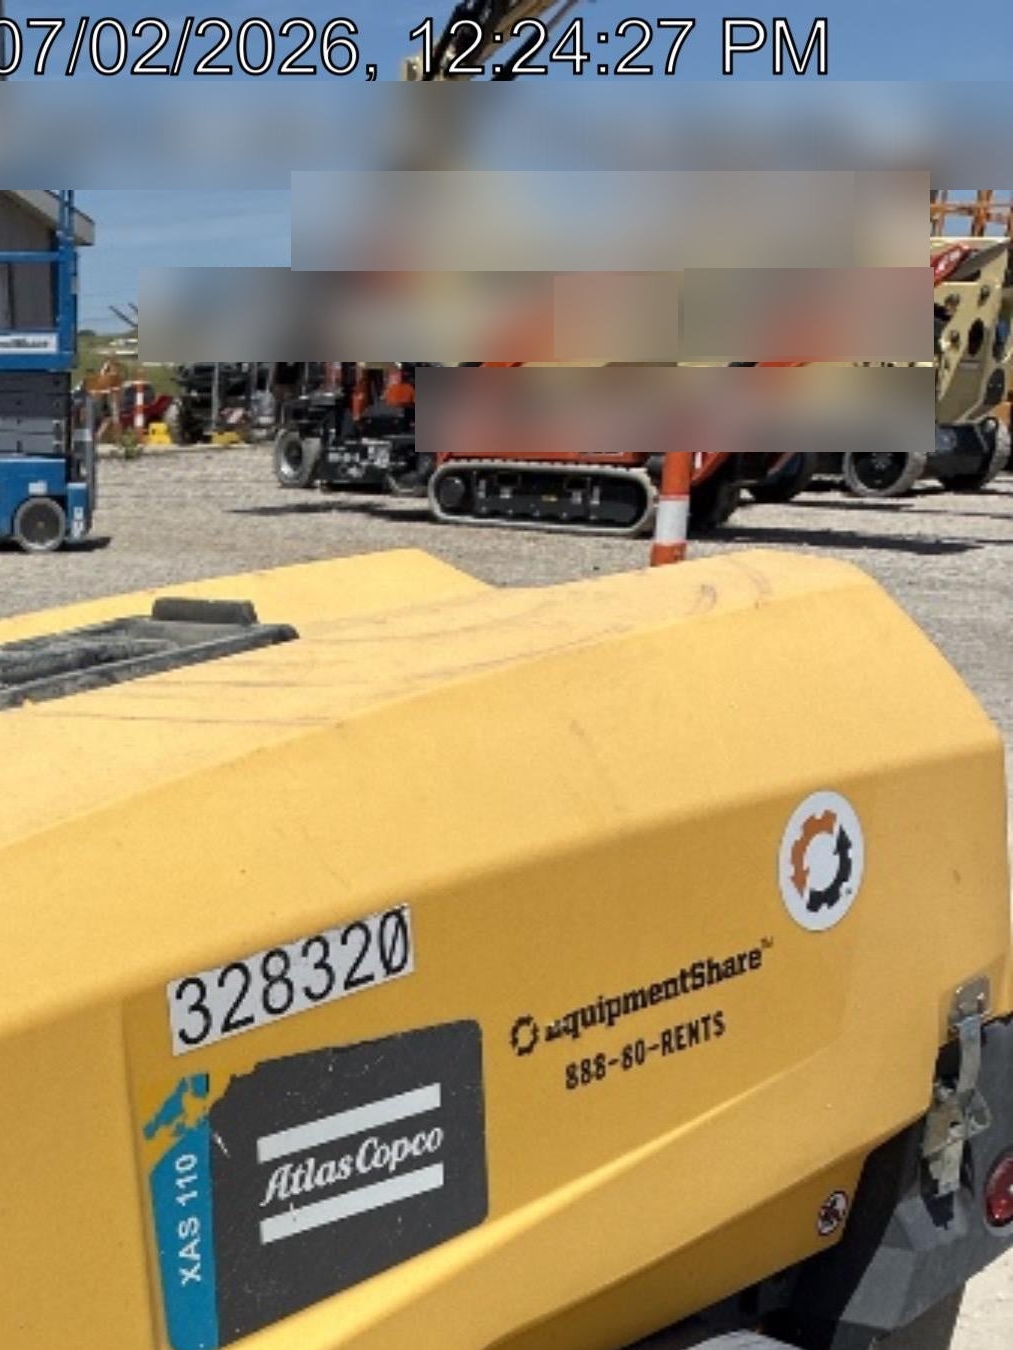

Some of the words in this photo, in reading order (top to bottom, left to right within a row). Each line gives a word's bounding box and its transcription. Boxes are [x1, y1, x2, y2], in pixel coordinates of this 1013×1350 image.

[176, 907, 408, 1044] 328320
[565, 1010, 726, 1090] 888-80-RENTS
[175, 1153, 198, 1207] 110
[259, 1153, 354, 1207] Atlas
[355, 1127, 444, 1173] Copco
[178, 1216, 201, 1286] XAS
